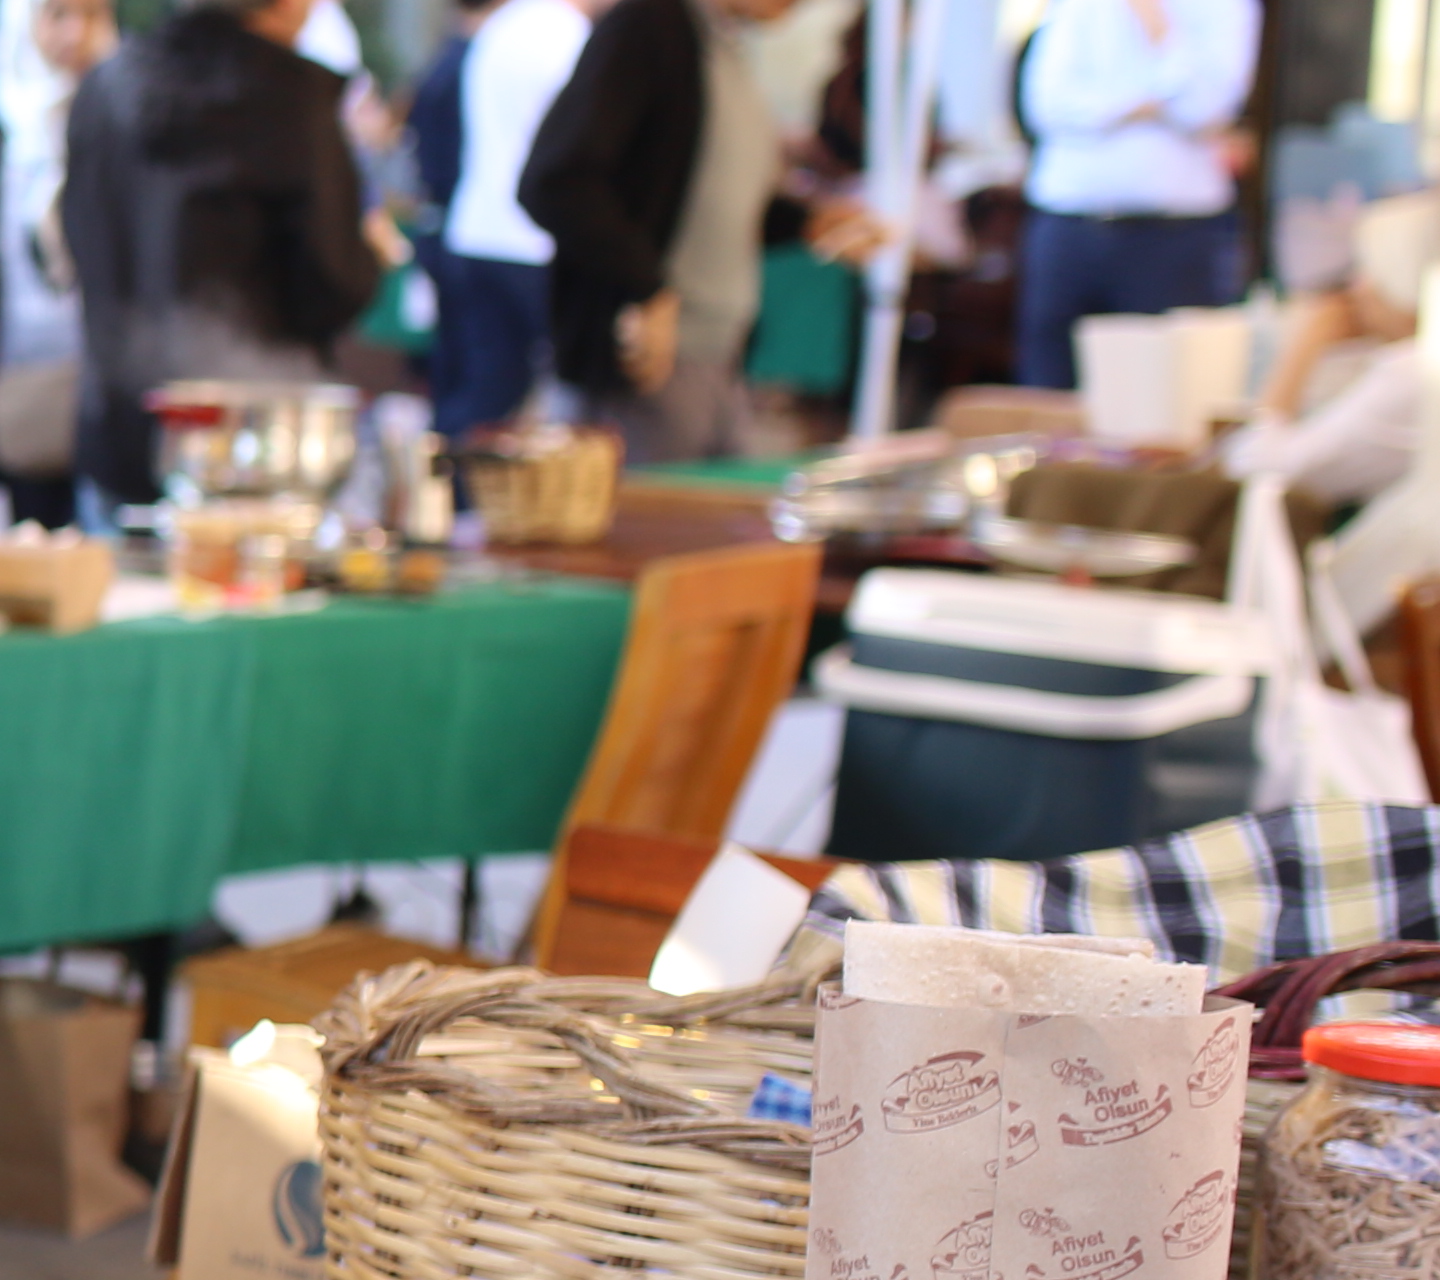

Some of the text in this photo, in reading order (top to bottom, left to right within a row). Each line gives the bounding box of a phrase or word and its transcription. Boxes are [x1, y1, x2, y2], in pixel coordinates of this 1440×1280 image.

[1084, 1079, 1140, 1107] Afiyet
[1094, 1099, 1150, 1122] Olsun
[1051, 1230, 1105, 1256] Afiyet
[830, 1254, 871, 1277] Afiyet
[1061, 1249, 1116, 1271] Olsun
